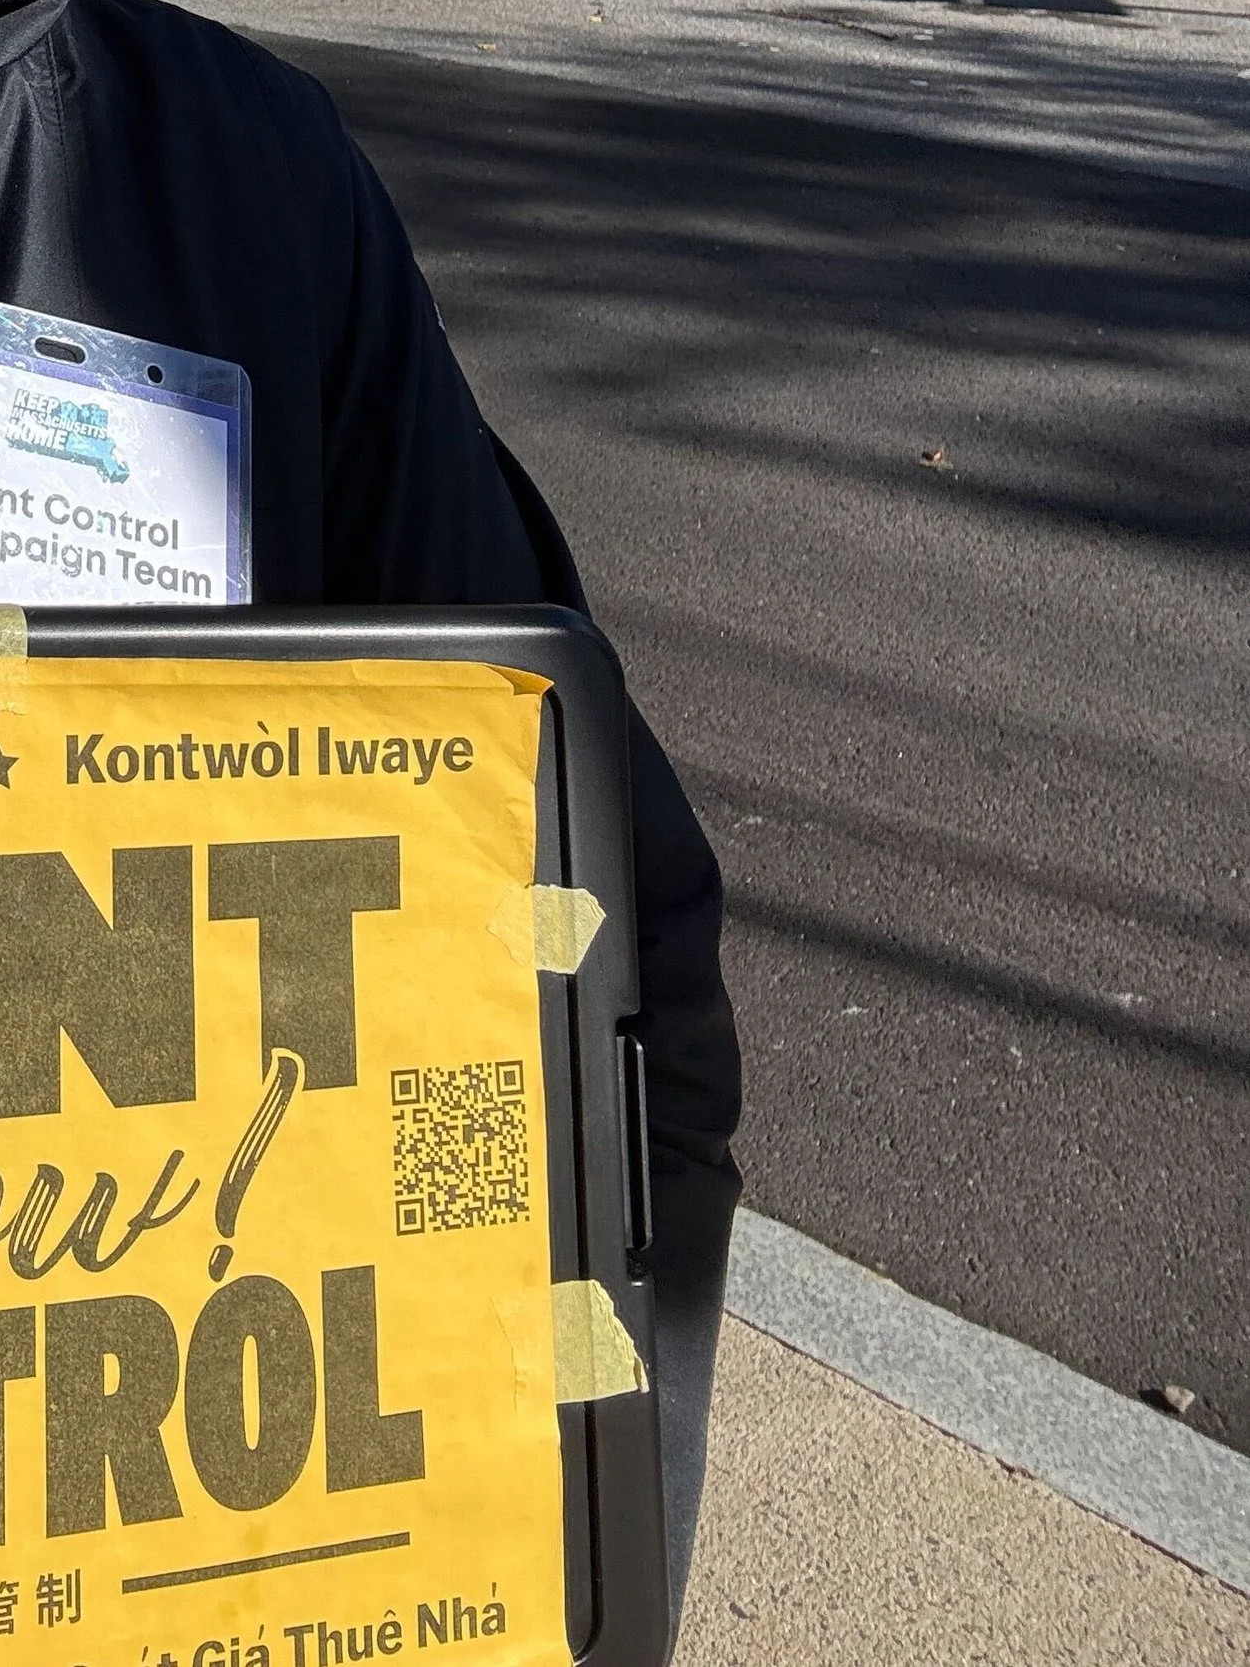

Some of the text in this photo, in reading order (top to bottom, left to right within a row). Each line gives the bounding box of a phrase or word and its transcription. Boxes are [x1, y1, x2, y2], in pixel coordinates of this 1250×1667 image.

[10, 406, 108, 440] MASSACHUSETTS
[13, 388, 61, 414] KEEP
[6, 417, 69, 451] HOME
[44, 494, 179, 551] Control
[116, 548, 212, 599] Team
[65, 720, 300, 785] Kontwòl
[283, 1609, 403, 1667] Thuê
